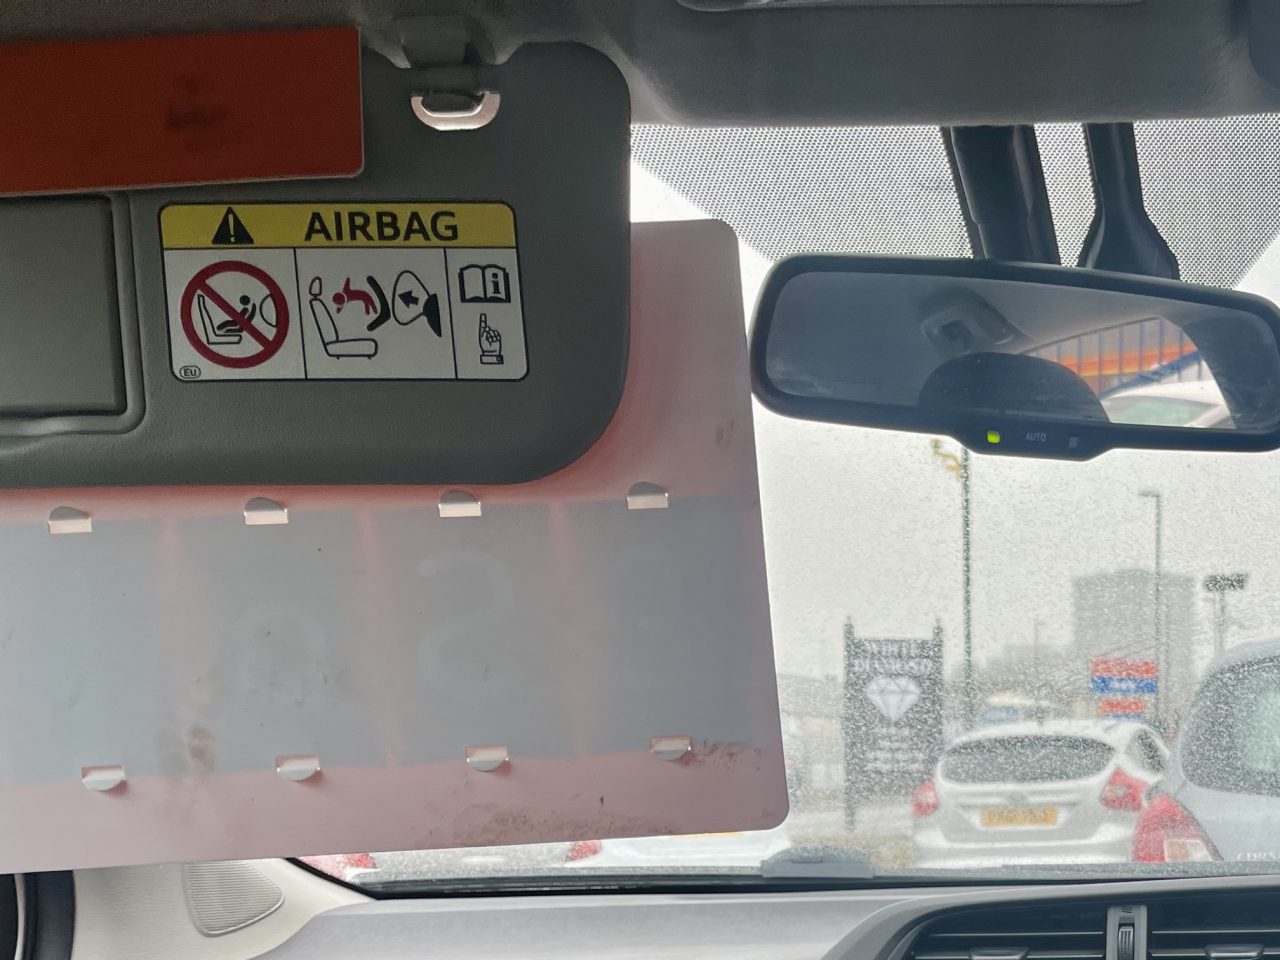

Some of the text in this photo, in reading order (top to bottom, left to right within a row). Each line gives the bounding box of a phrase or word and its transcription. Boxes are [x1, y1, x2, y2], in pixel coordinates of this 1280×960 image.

[304, 211, 459, 242] AIRBAG
[183, 368, 197, 377] EU
[1025, 432, 1047, 443] AUTO
